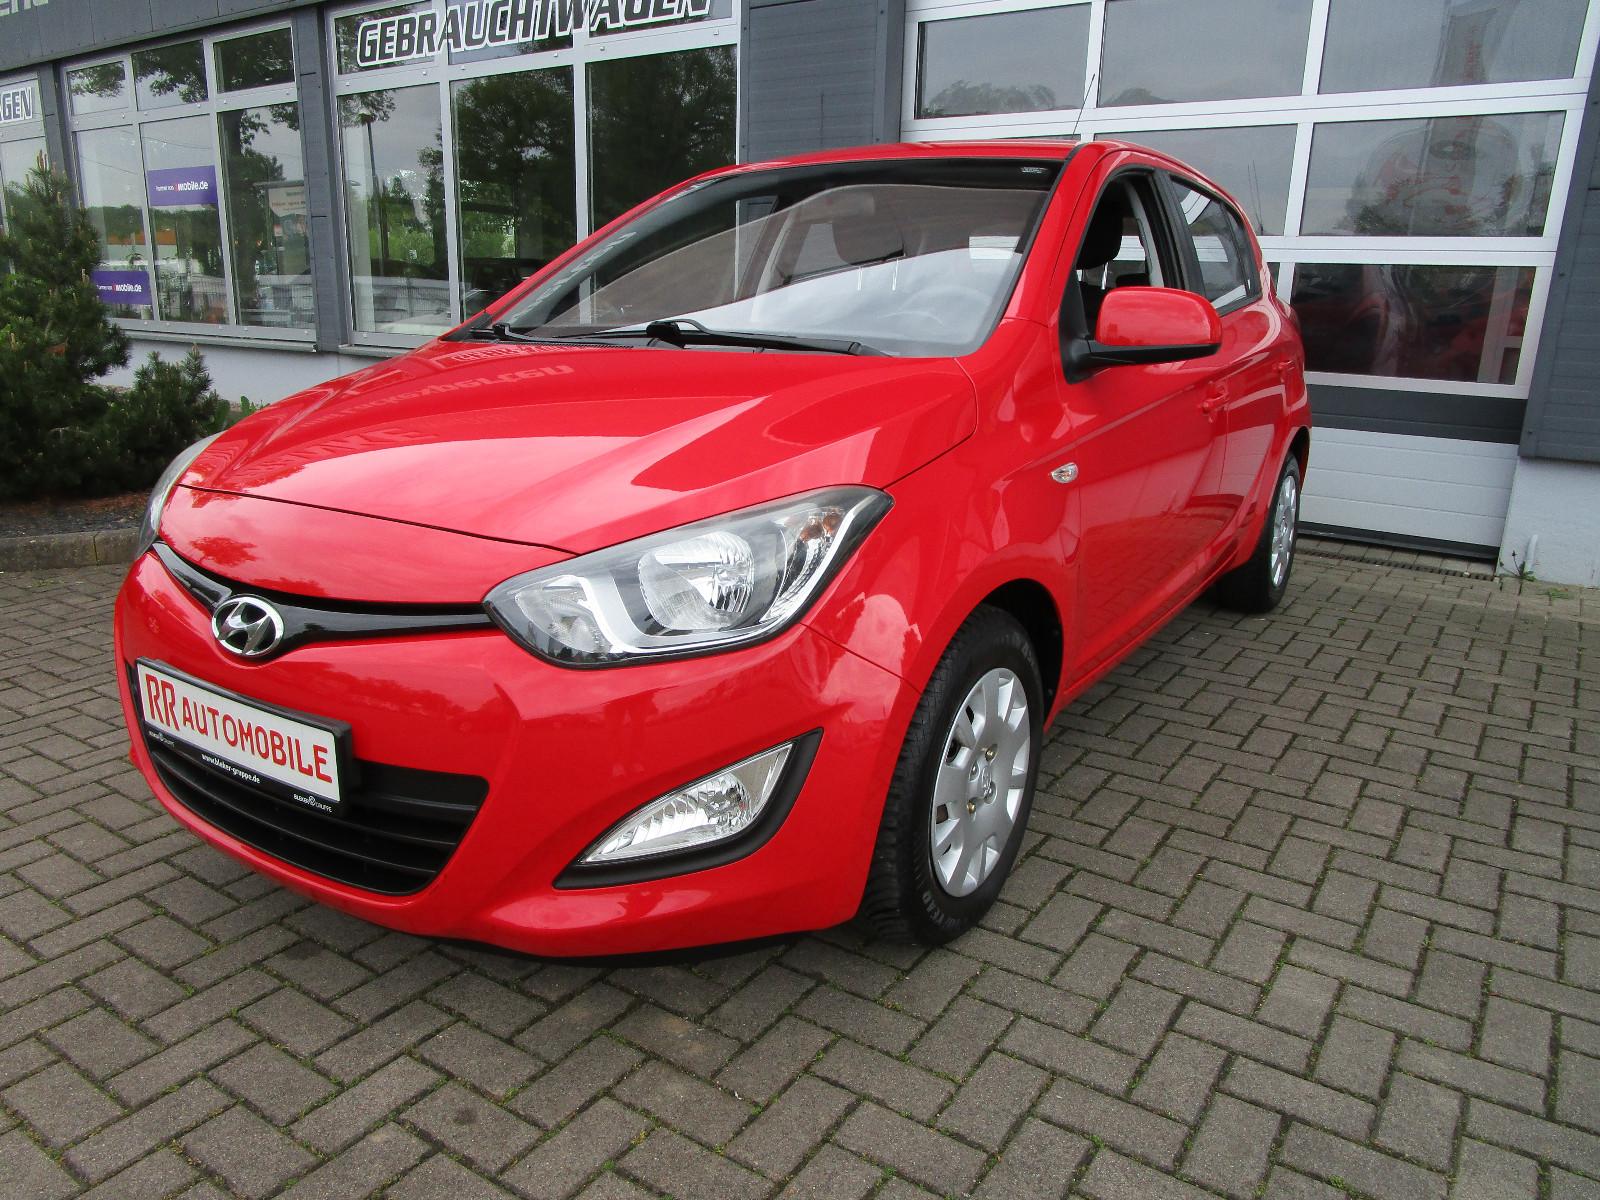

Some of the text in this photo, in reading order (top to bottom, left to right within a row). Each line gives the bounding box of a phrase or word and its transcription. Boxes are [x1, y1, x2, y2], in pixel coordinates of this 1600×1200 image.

[177, 180, 209, 191] mobile.de
[145, 674, 333, 784] RR AUTOMOBILE
